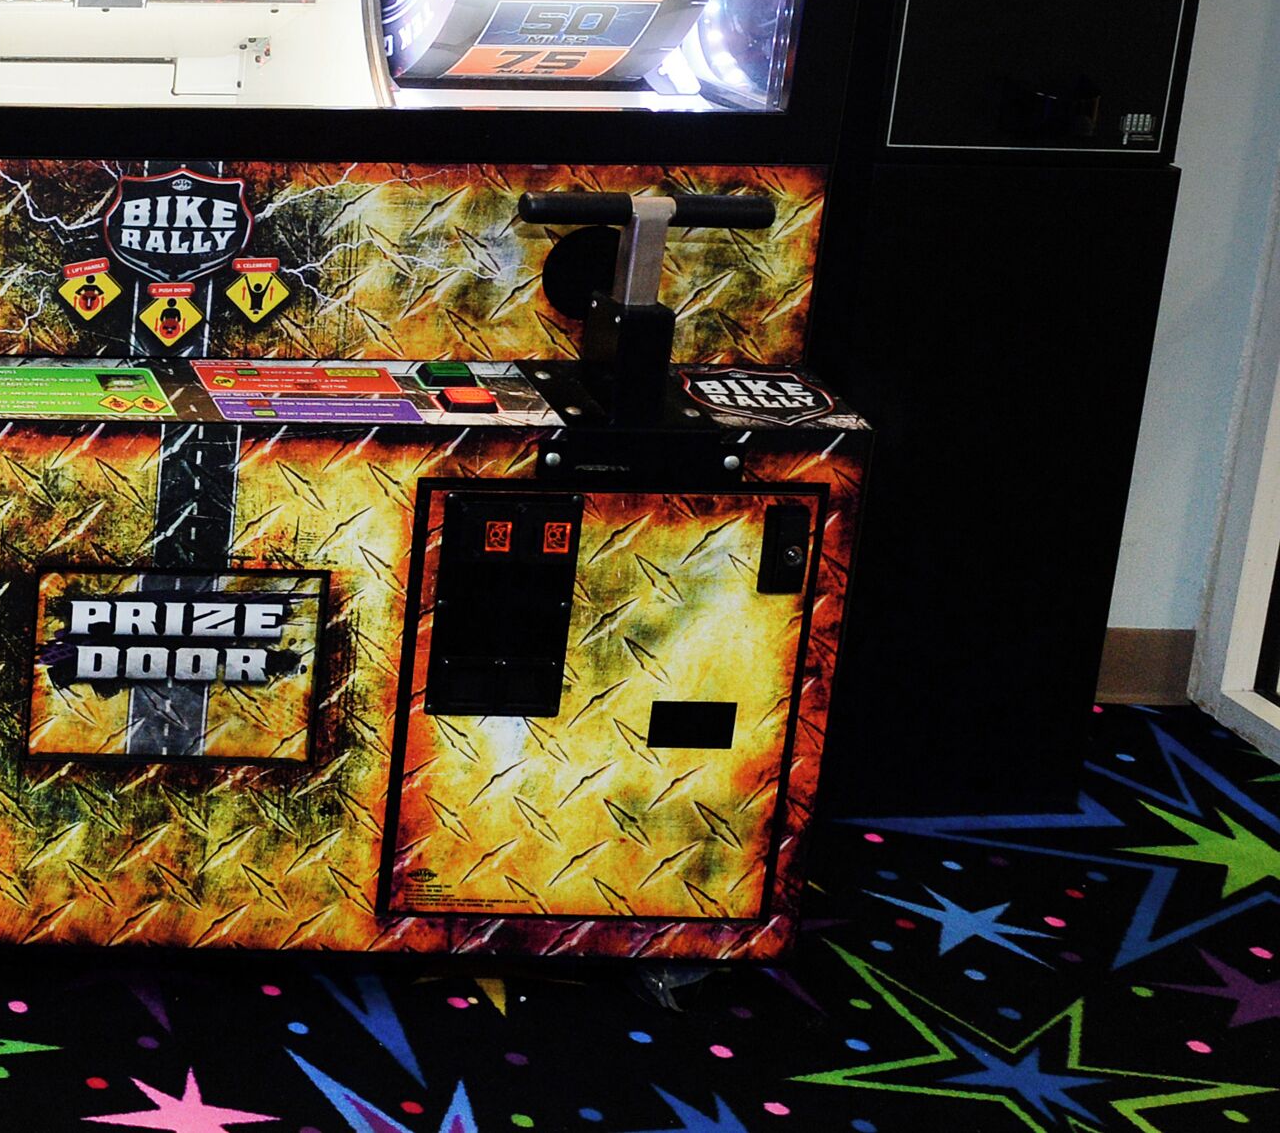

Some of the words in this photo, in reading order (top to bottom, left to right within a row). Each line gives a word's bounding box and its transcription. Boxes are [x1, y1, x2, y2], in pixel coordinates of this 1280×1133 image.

[518, 5, 619, 36] 50
[526, 35, 590, 45] MILES
[492, 51, 588, 70] 75
[122, 195, 238, 228] BIKE
[120, 230, 236, 254] RALLY
[72, 266, 83, 274] LIFT
[694, 379, 813, 396] BIKE
[706, 394, 816, 408] RALLY
[68, 601, 286, 638] PRIZE
[75, 645, 271, 684] DOOR
